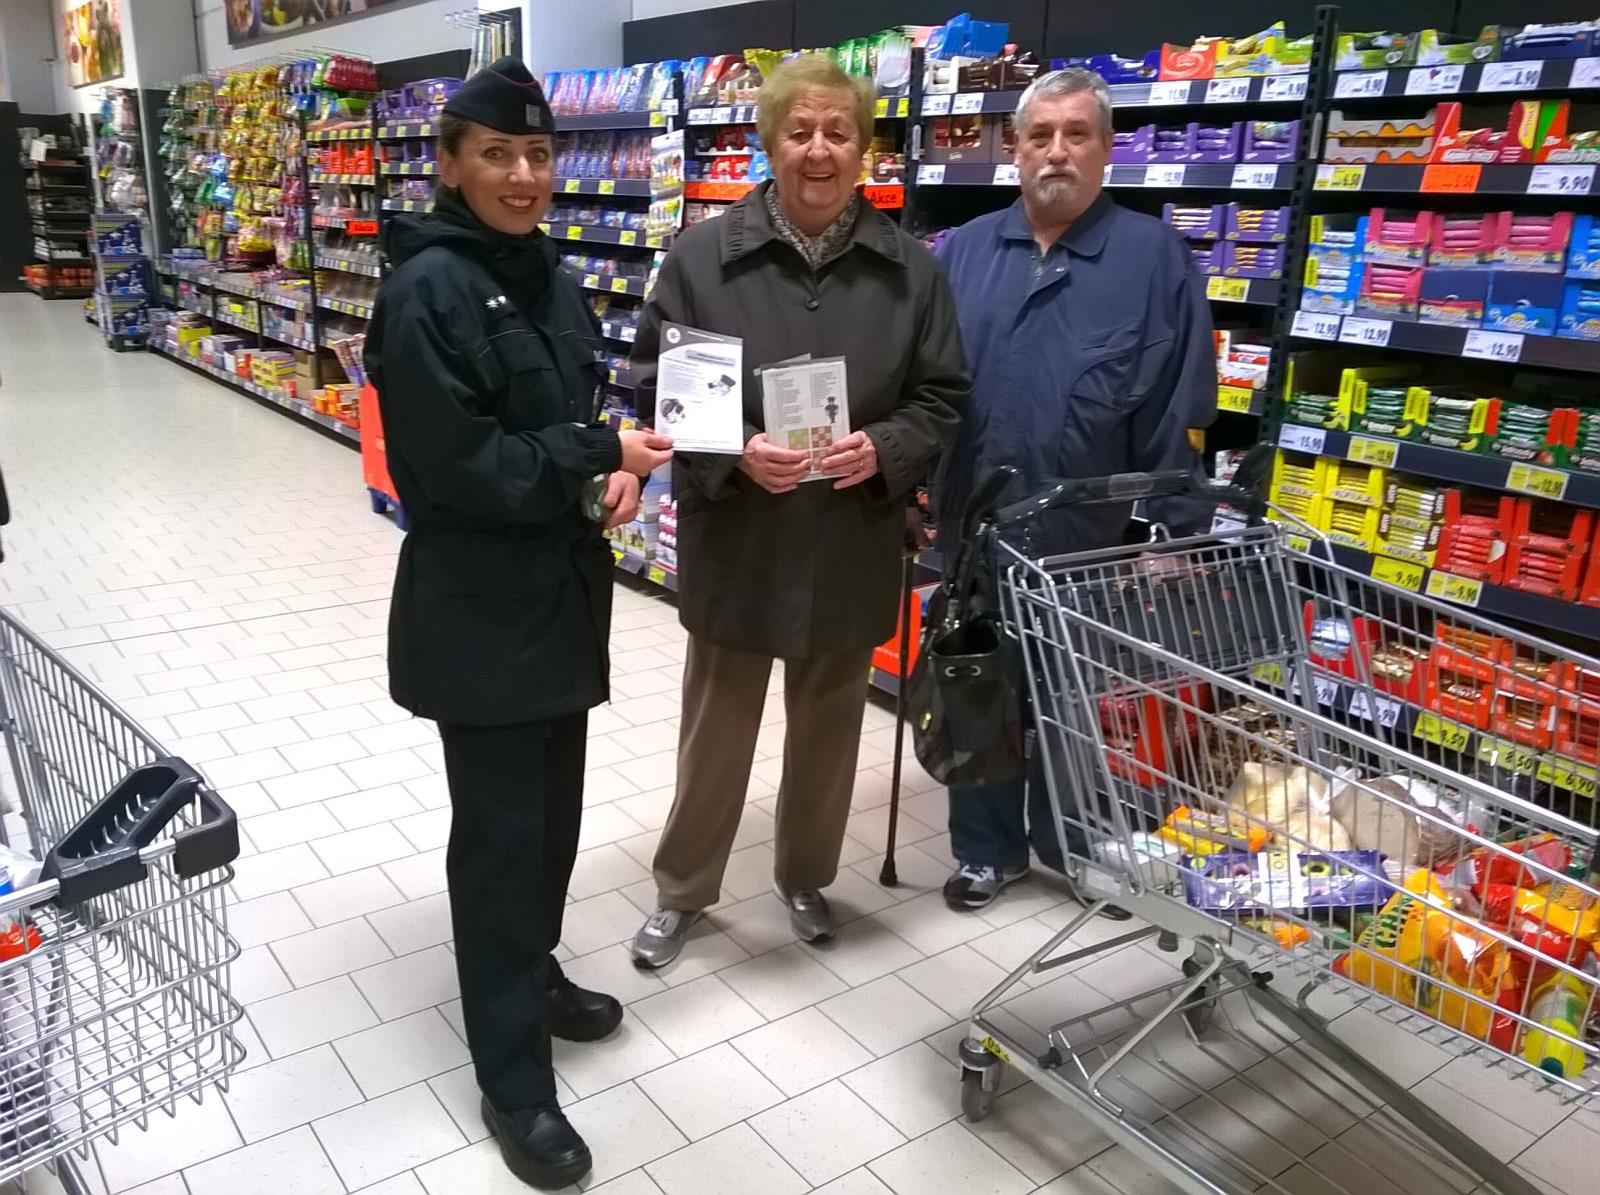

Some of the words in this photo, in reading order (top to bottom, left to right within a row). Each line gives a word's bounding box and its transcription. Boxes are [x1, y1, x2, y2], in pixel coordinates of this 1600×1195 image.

[1559, 175, 1590, 190] 9.90
[1314, 321, 1338, 336] 12.90
[1363, 327, 1387, 342] 12.90
[1490, 341, 1519, 358] 12.90
[1395, 570, 1420, 588] 9.90
